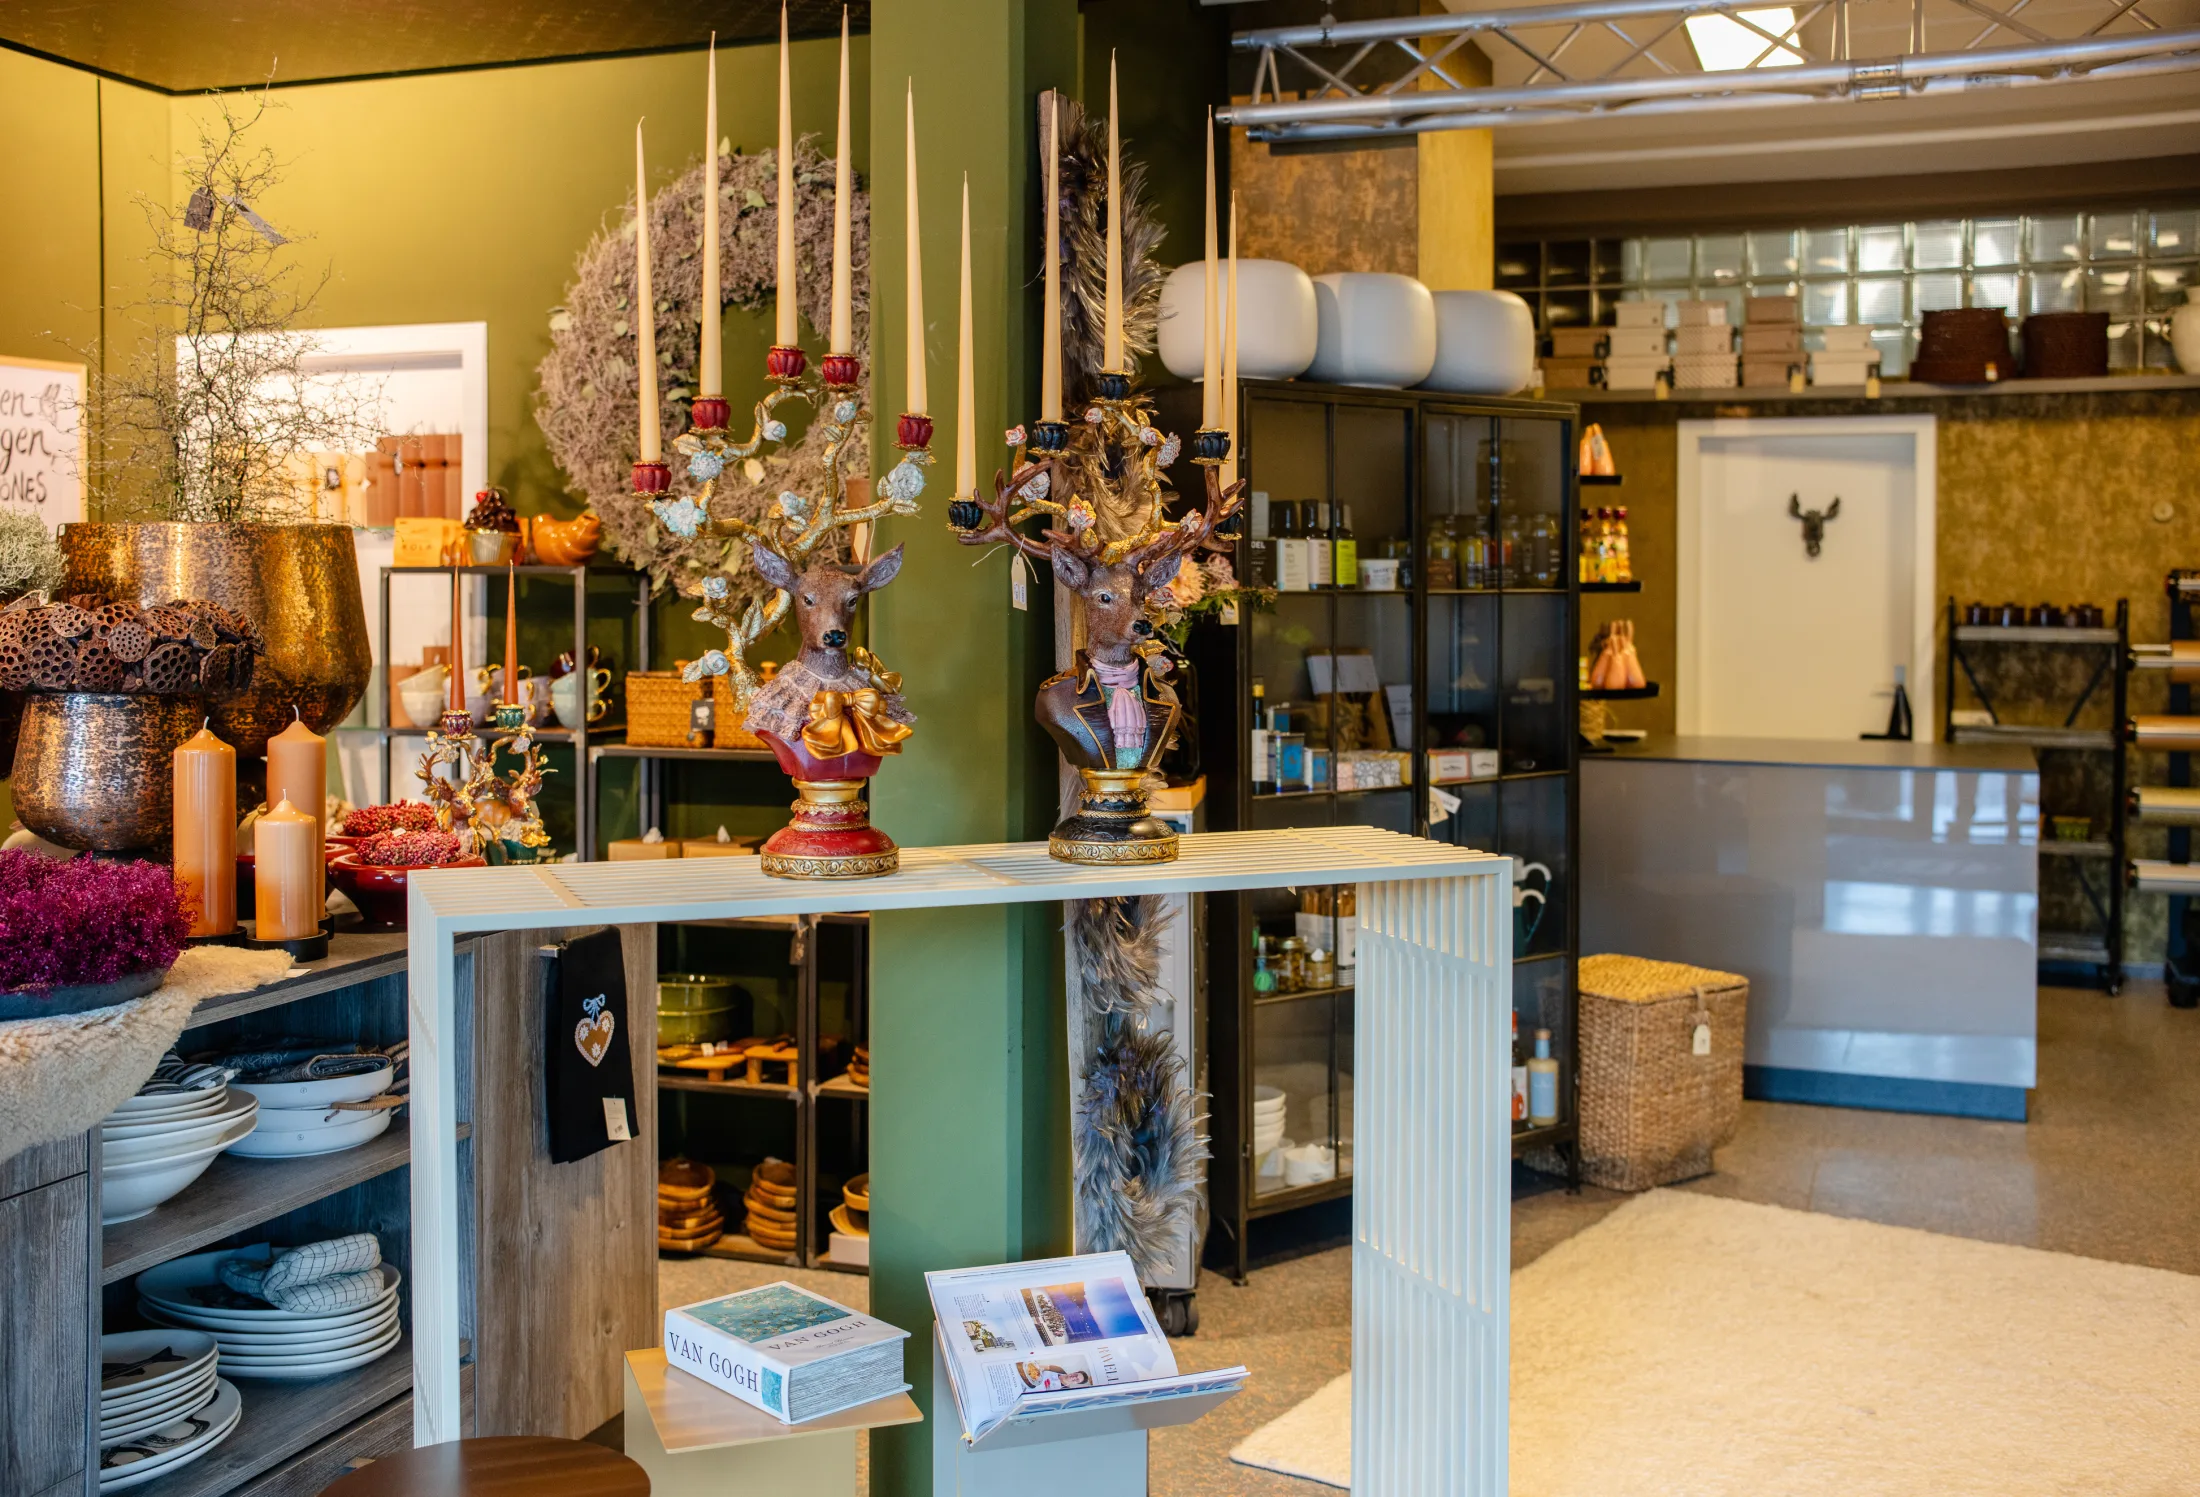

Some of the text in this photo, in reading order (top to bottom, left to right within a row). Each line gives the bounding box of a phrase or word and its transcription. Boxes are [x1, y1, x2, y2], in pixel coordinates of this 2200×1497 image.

[767, 1335, 810, 1350] VAN
[813, 1320, 868, 1339] GOGH
[669, 1331, 758, 1393] VAN GOGH
